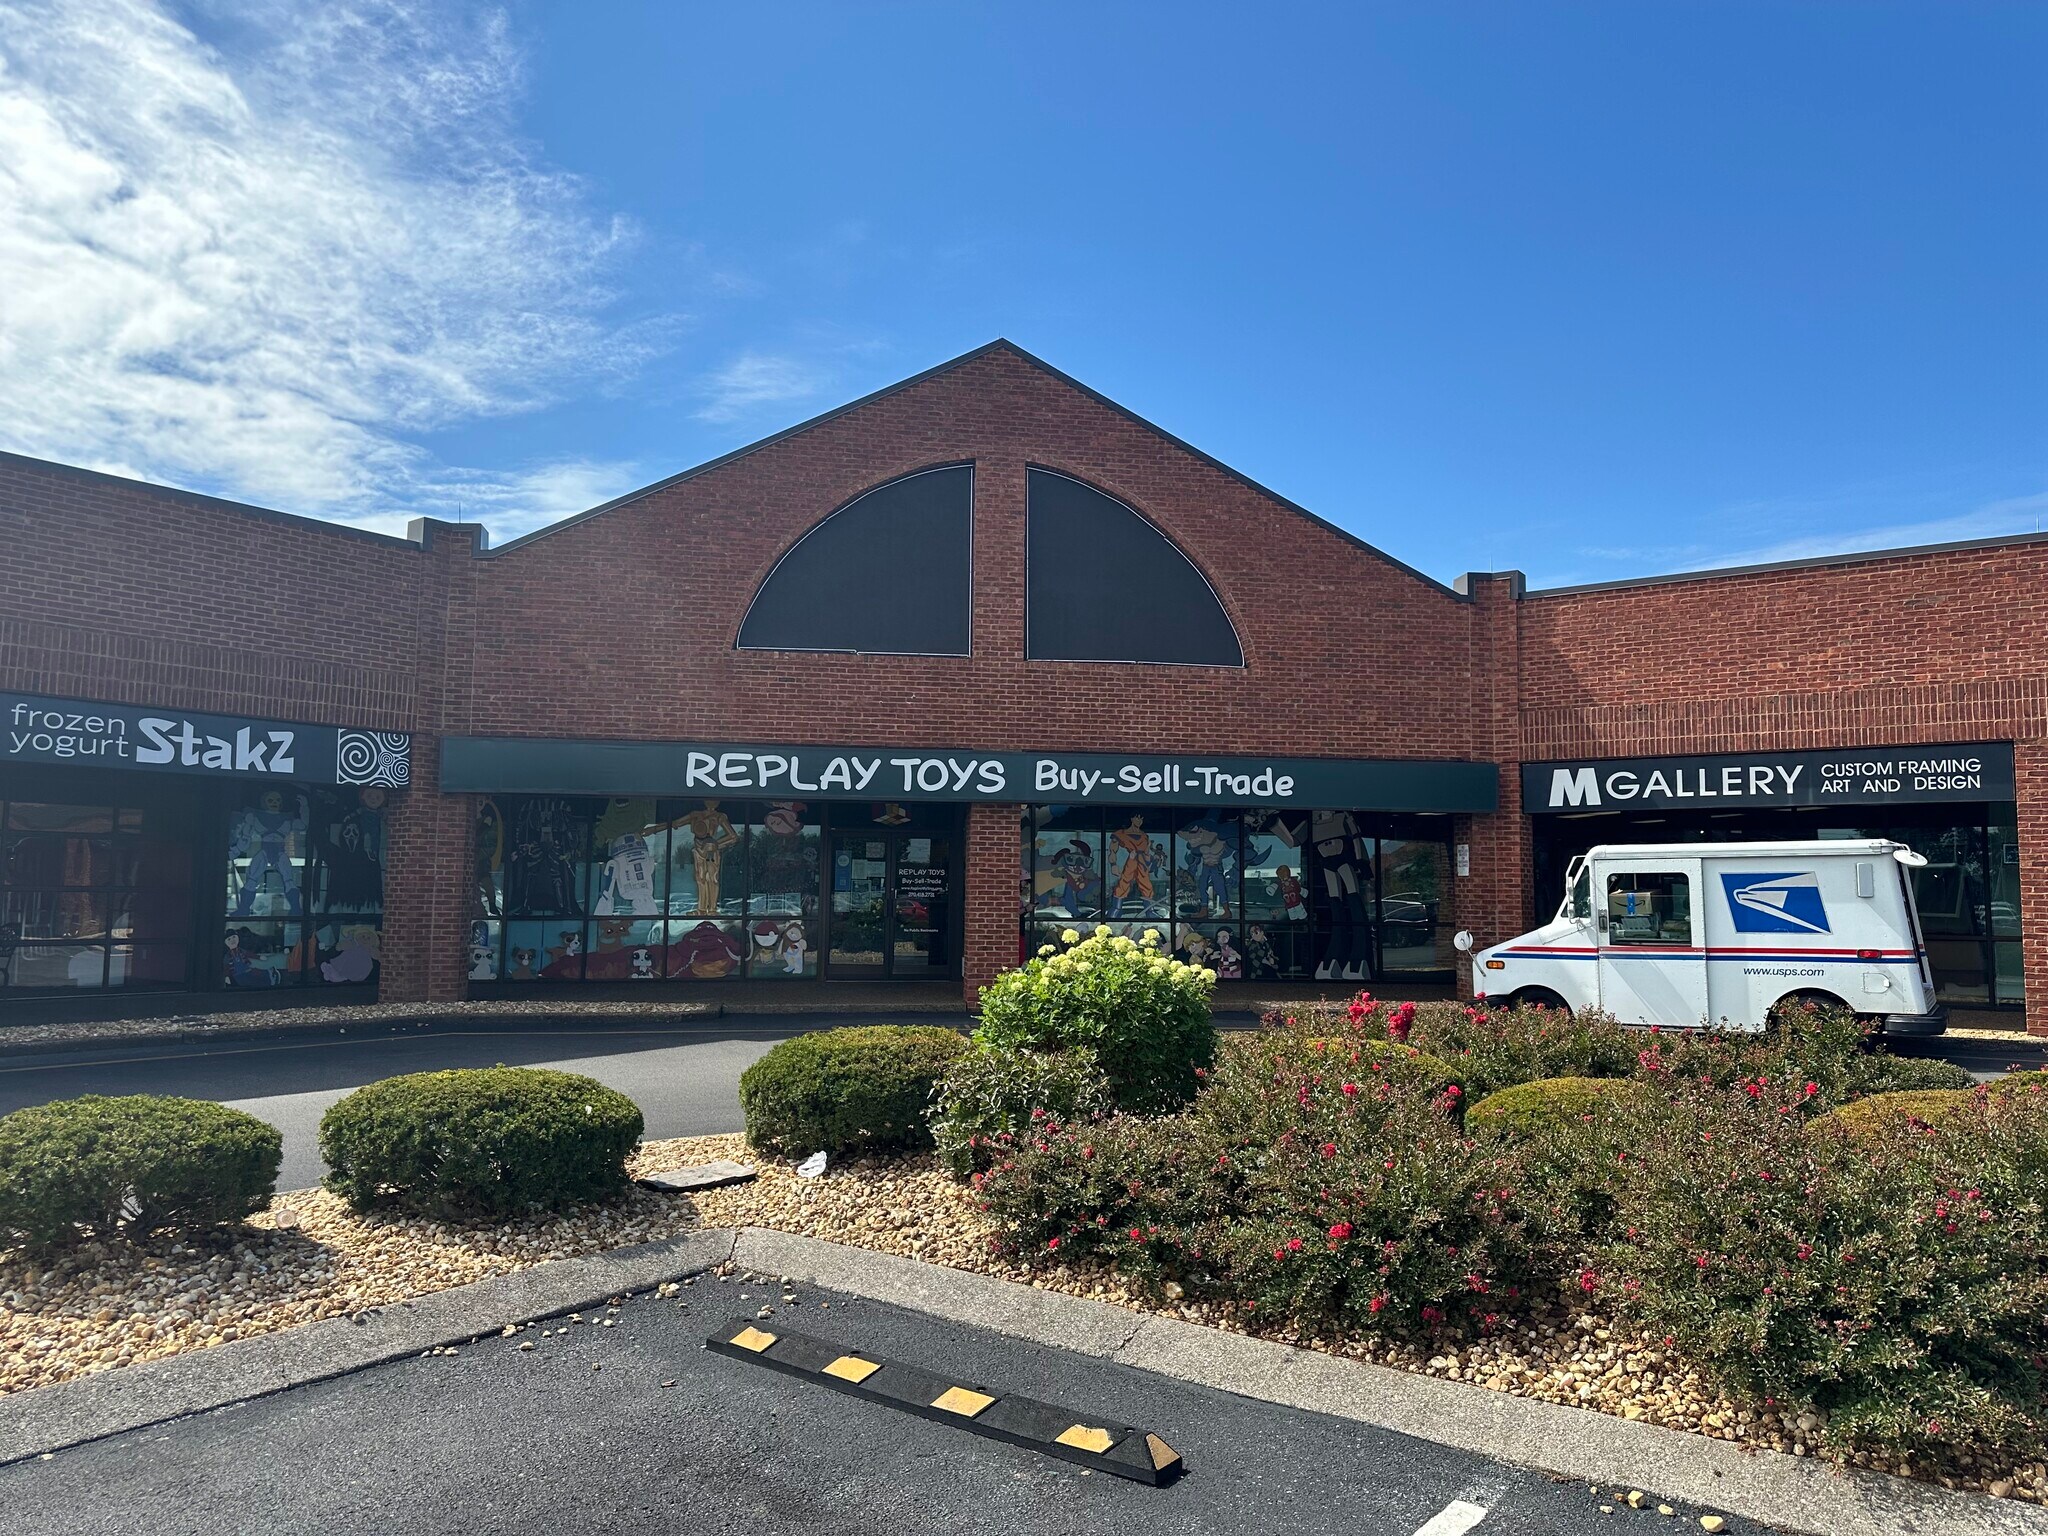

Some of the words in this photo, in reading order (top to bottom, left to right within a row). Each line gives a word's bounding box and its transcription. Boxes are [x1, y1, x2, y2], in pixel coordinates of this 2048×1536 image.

[10, 703, 126, 736] frozen
[9, 731, 129, 758] yogurt
[685, 751, 882, 791] REPLAY
[890, 757, 1006, 793] TOYS
[1035, 759, 1294, 797] Buy-Sell-Trade
[1820, 761, 1893, 778] CUSTOM
[1898, 758, 1982, 775] FRAMING
[1548, 767, 1602, 807] M
[1605, 764, 1804, 800] GALLERY
[1820, 779, 1851, 793] ART
[1862, 778, 1901, 793] AND
[1914, 774, 1982, 791] DESIGN
[898, 868, 927, 876] REPLAY
[927, 868, 946, 876] TOYS
[1743, 967, 1825, 978] www.usps.com
